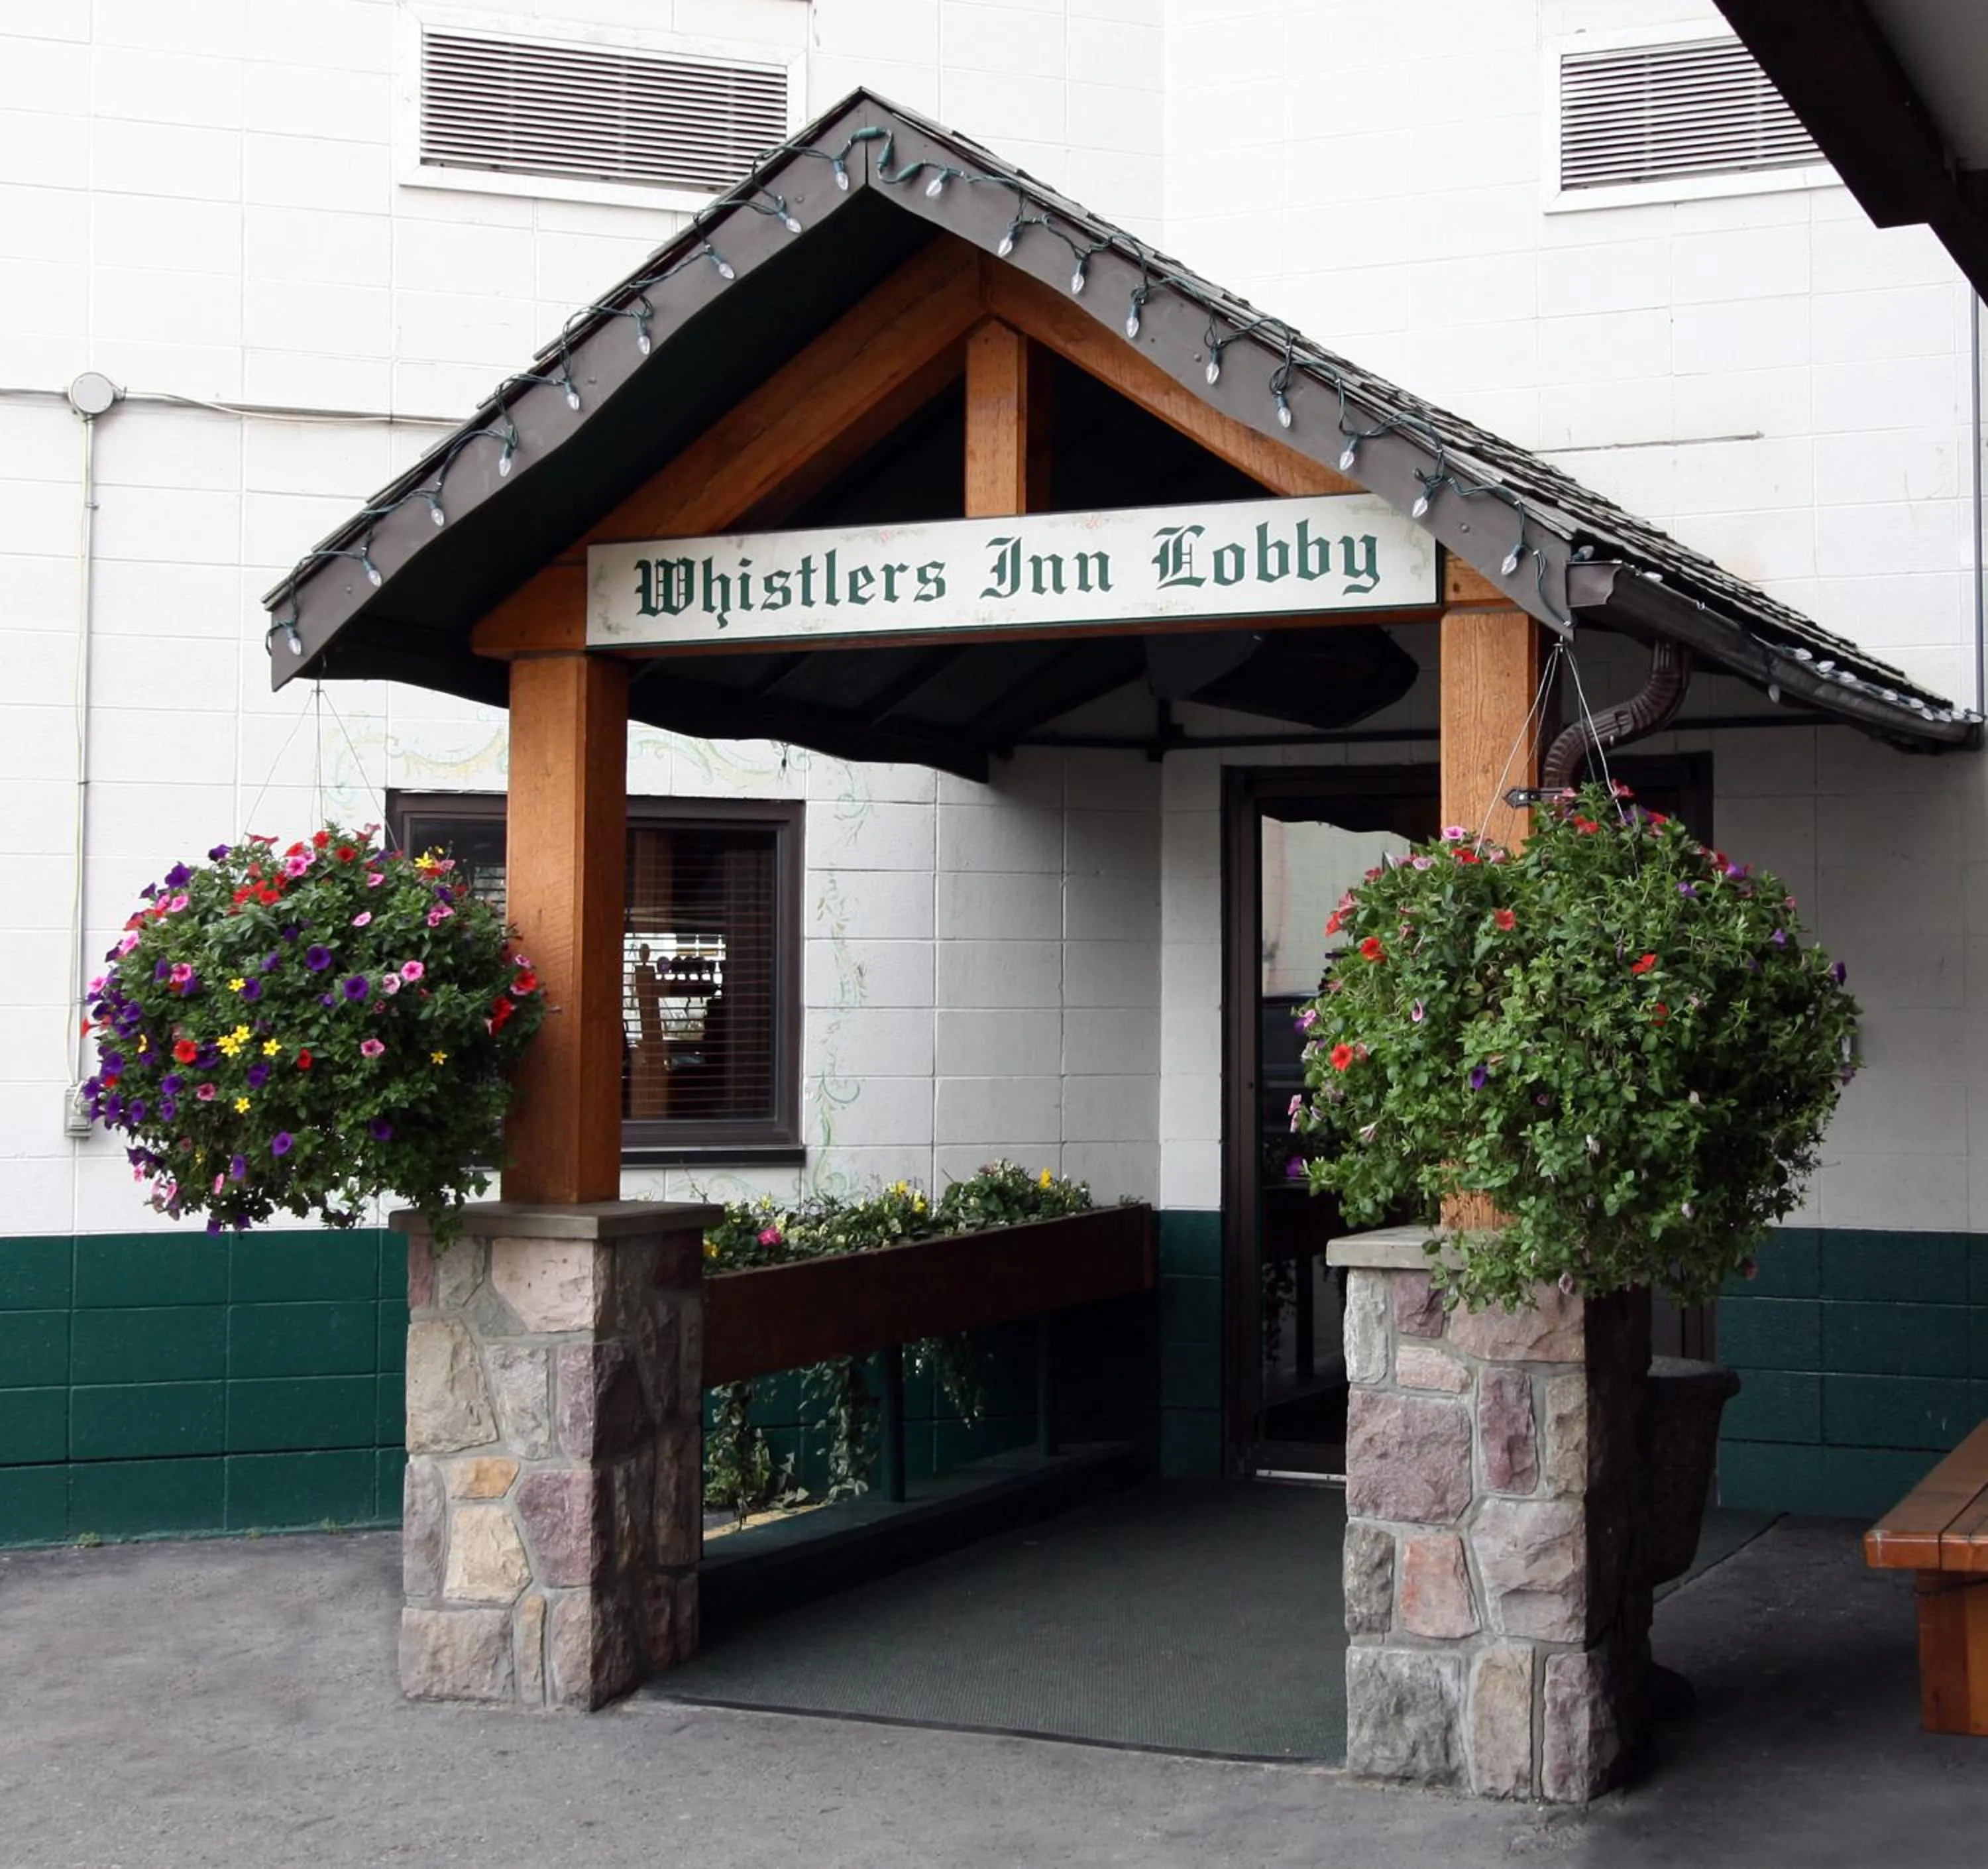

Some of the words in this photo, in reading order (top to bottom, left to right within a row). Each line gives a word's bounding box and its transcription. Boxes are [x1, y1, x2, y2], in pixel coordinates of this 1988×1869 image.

[633, 548, 946, 629] Whistlers
[979, 536, 1115, 599] Inn
[1151, 518, 1380, 596] Lobby
